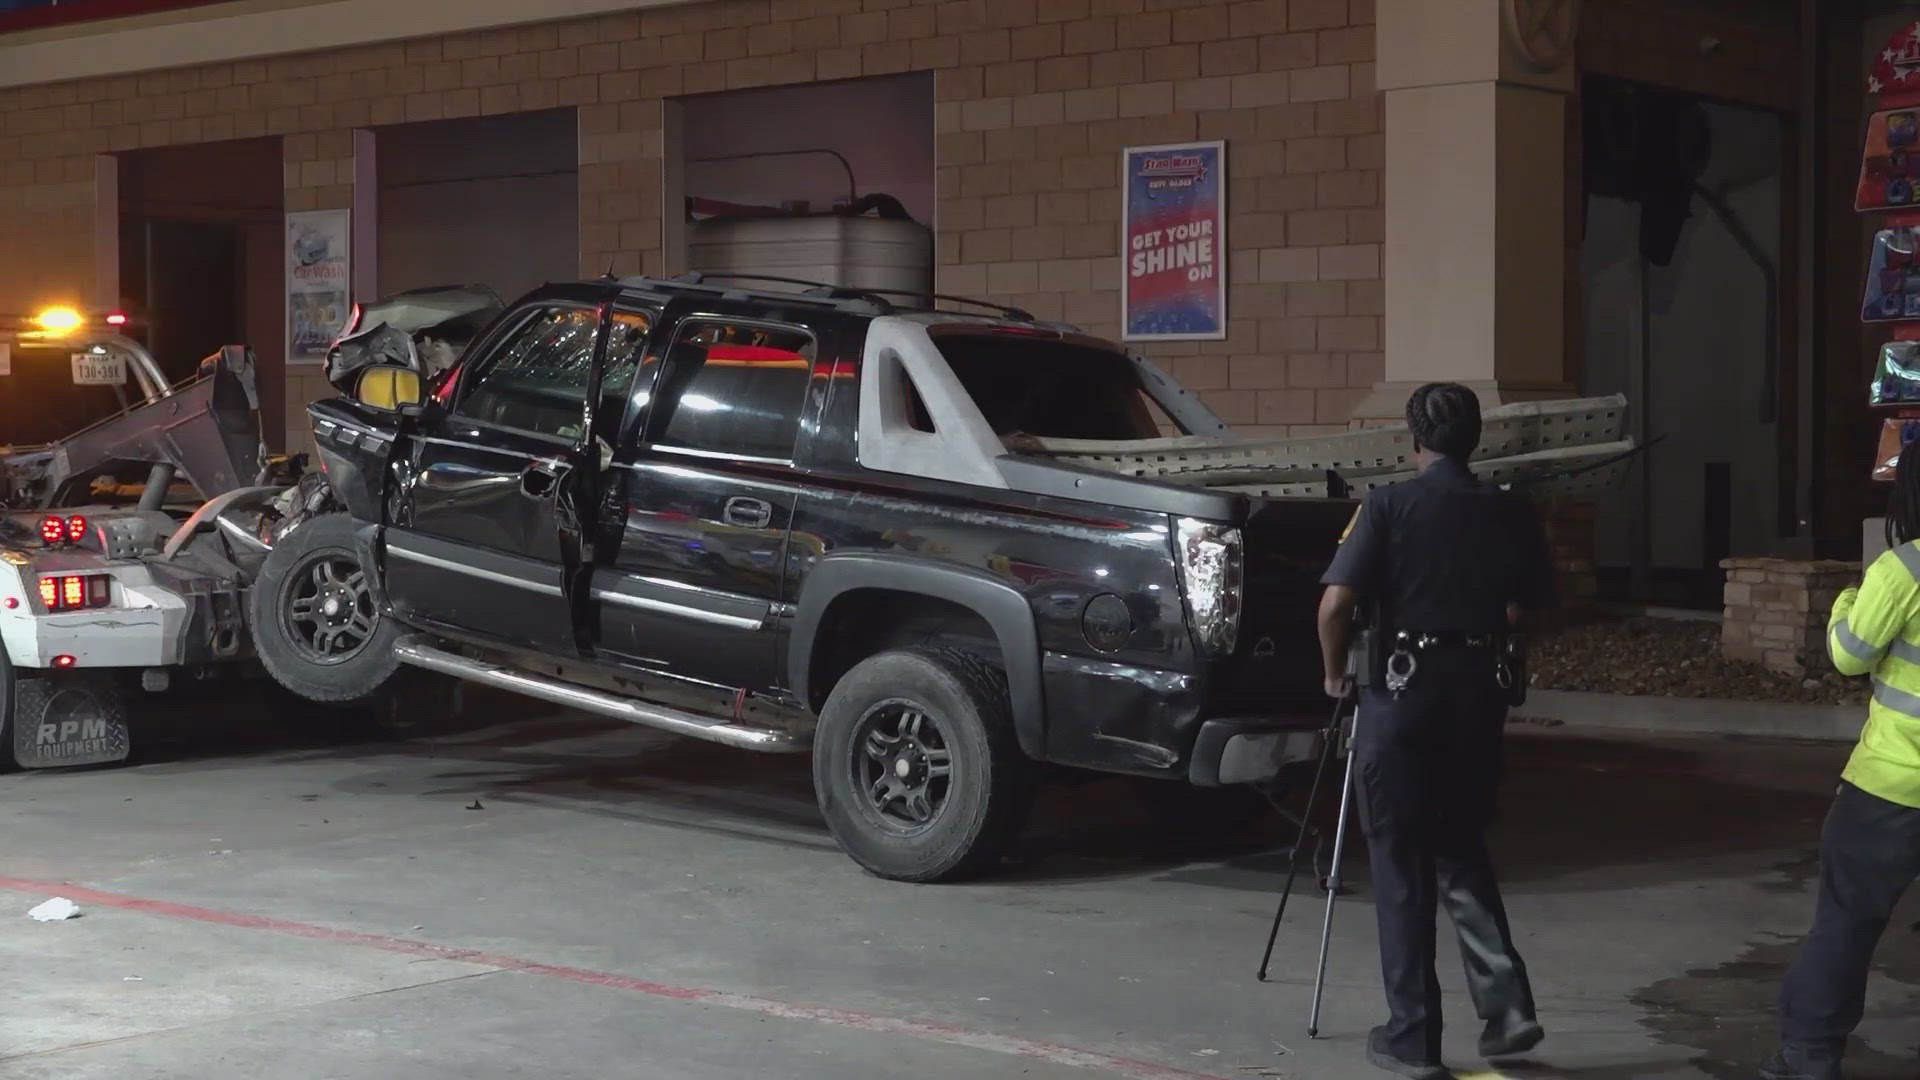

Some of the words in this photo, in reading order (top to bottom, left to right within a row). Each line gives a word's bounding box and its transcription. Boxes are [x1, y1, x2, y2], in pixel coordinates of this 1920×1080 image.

[1132, 230, 1162, 250] GET
[1166, 219, 1213, 242] YOUR
[1131, 238, 1213, 277] SHINE
[1188, 263, 1213, 281] ON
[36, 718, 107, 745] RPM
[36, 737, 107, 759] EQUIPMENT
